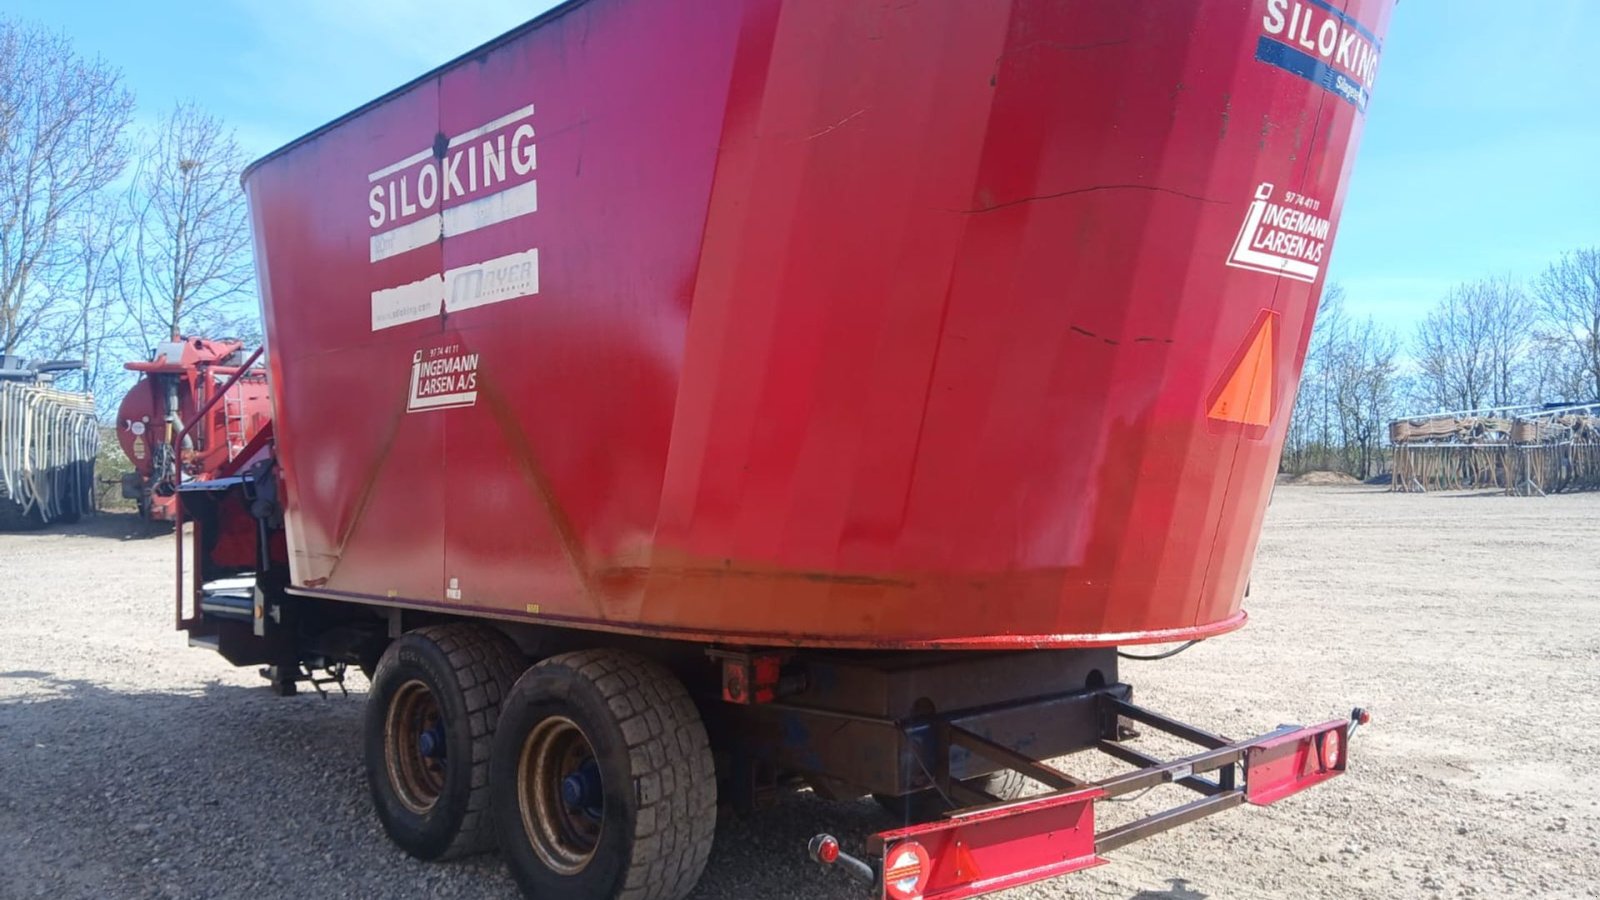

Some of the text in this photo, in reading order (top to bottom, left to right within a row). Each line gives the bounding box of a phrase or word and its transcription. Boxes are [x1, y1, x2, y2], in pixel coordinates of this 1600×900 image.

[1263, 0, 1377, 88] SILOKING
[369, 124, 537, 229] SILOKING
[1262, 203, 1330, 240] INGEMANN
[1253, 227, 1325, 263] LARSEN A/S
[418, 372, 476, 395] LARSEN A/S
[420, 354, 478, 378] INGEMANN
